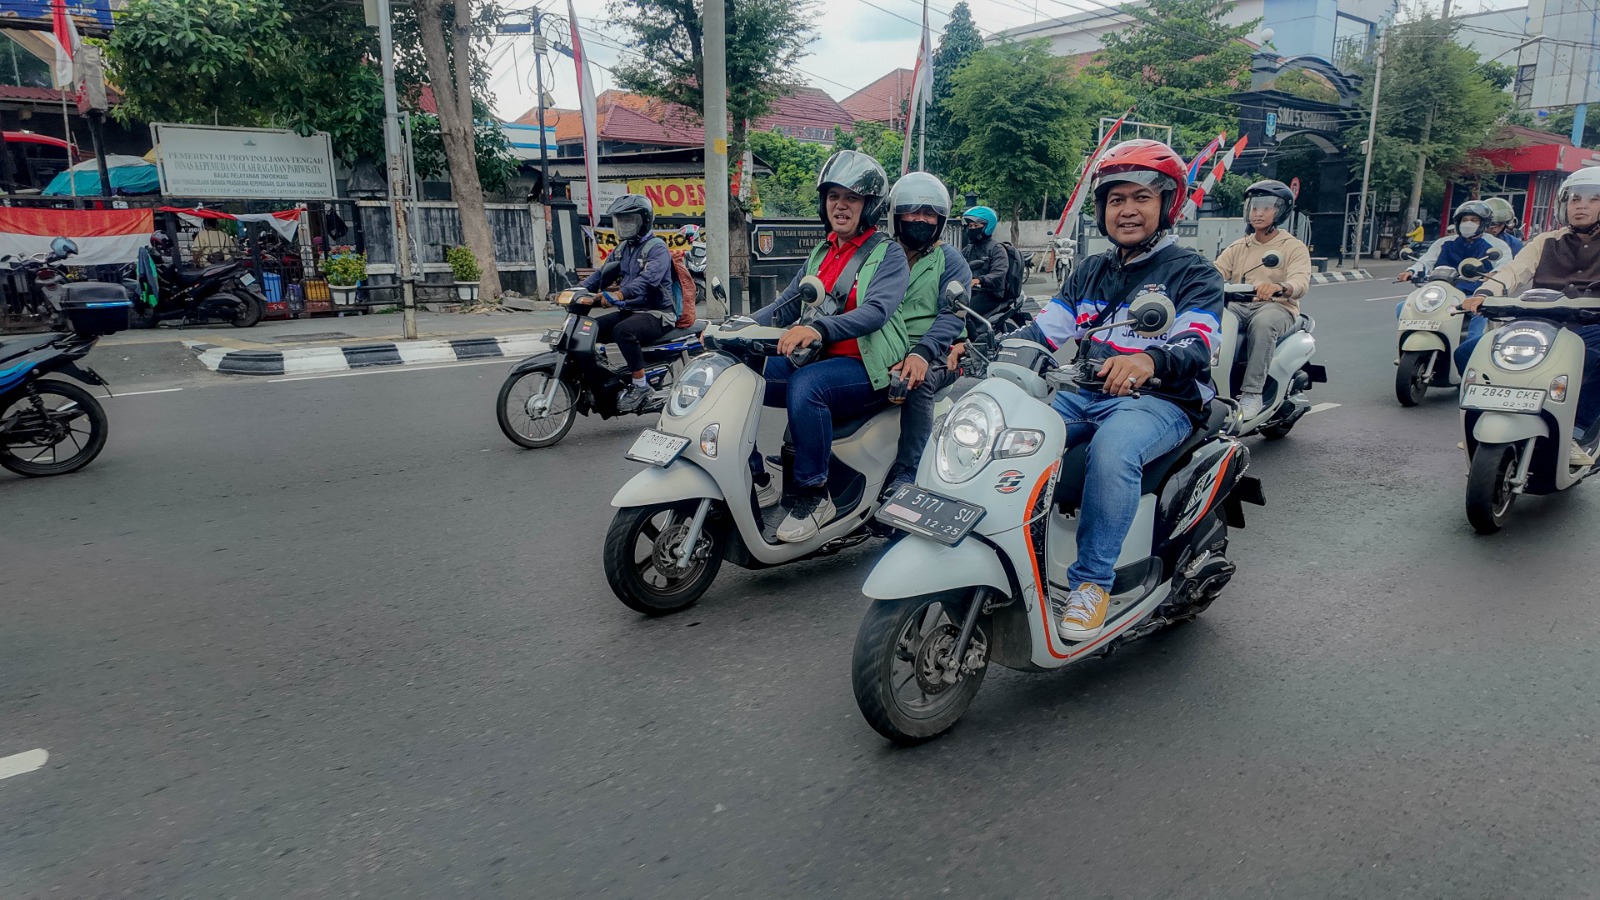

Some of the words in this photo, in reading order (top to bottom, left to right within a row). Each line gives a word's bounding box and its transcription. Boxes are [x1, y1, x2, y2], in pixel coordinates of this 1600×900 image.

[1277, 107, 1294, 126] SMA
[1294, 110, 1301, 127] 5
[168, 151, 226, 161] PEMERINTAH
[228, 153, 267, 163] PROVINSI
[268, 155, 291, 164] JAWA
[291, 156, 324, 165] TENGAH
[174, 161, 194, 170] DINAS
[195, 161, 238, 172] KEPEMUDAAN
[257, 164, 274, 173] RAGA
[274, 165, 287, 174] DAN
[287, 165, 322, 175] PARIWISATA
[1468, 387, 1477, 396] H
[1482, 387, 1512, 398] 2849
[1515, 390, 1540, 401] CKE
[895, 489, 910, 500] H
[911, 493, 945, 513] 5171
[954, 508, 976, 523] SU
